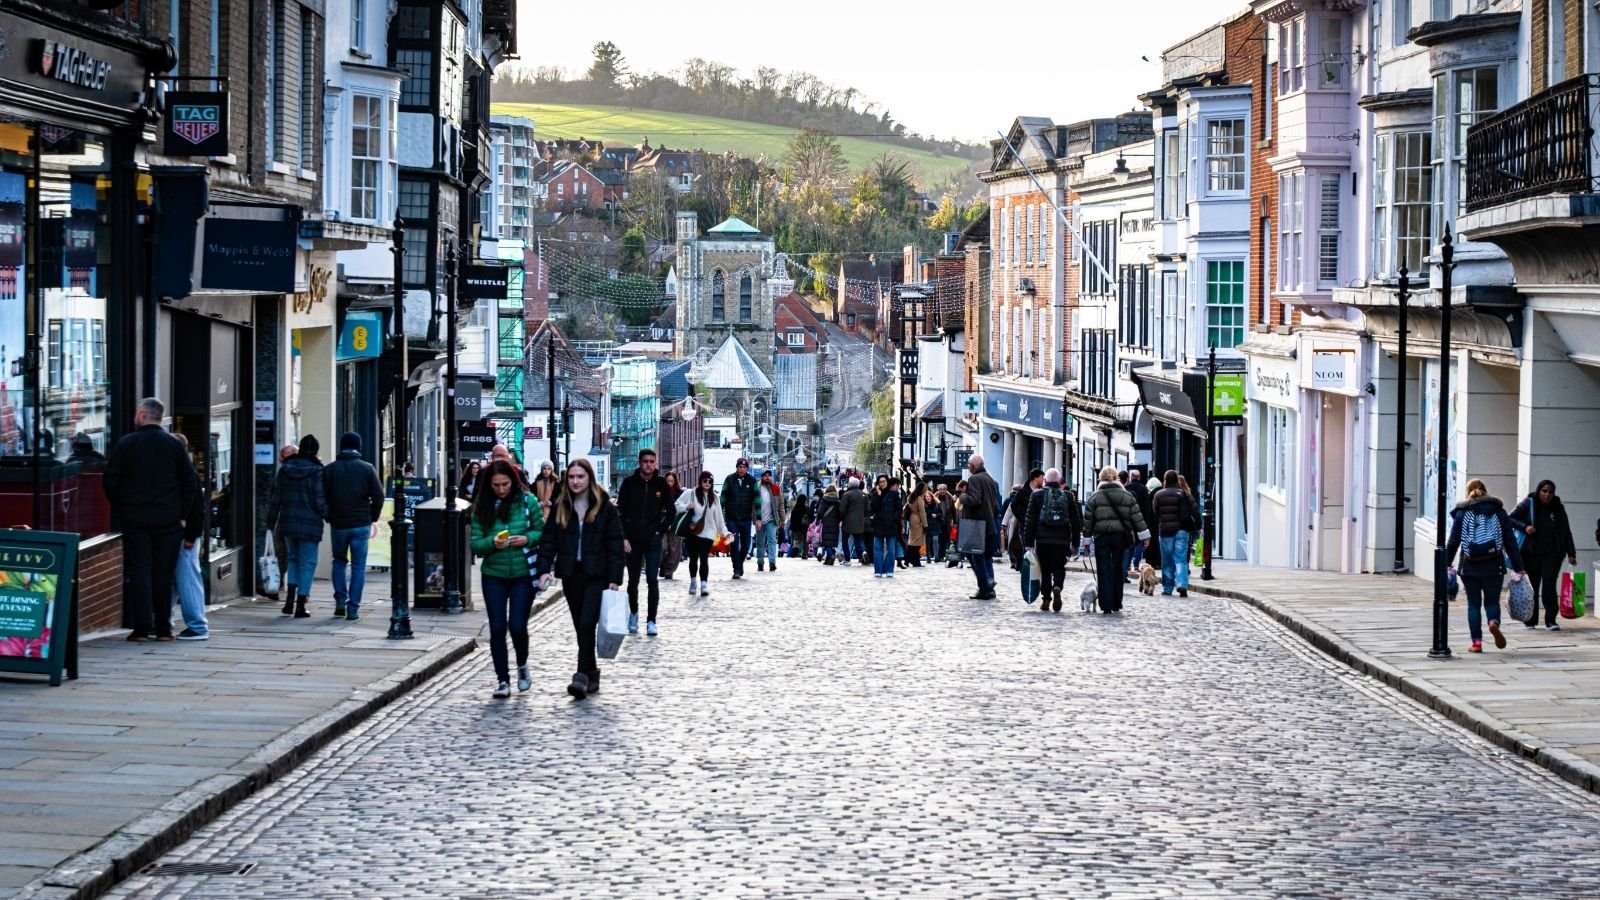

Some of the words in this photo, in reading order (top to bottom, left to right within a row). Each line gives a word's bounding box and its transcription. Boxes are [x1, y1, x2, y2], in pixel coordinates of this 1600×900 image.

[176, 107, 216, 120] TAG
[175, 122, 217, 141] HEUER
[208, 243, 249, 257] Mappin
[251, 245, 260, 256] &
[262, 246, 292, 257] Webb
[466, 278, 506, 286] WHISTLES
[1315, 371, 1343, 379] NEOM
[455, 397, 477, 406] OSS
[463, 435, 493, 443] REISS
[16, 553, 44, 563] IVY
[10, 596, 40, 605] DINING
